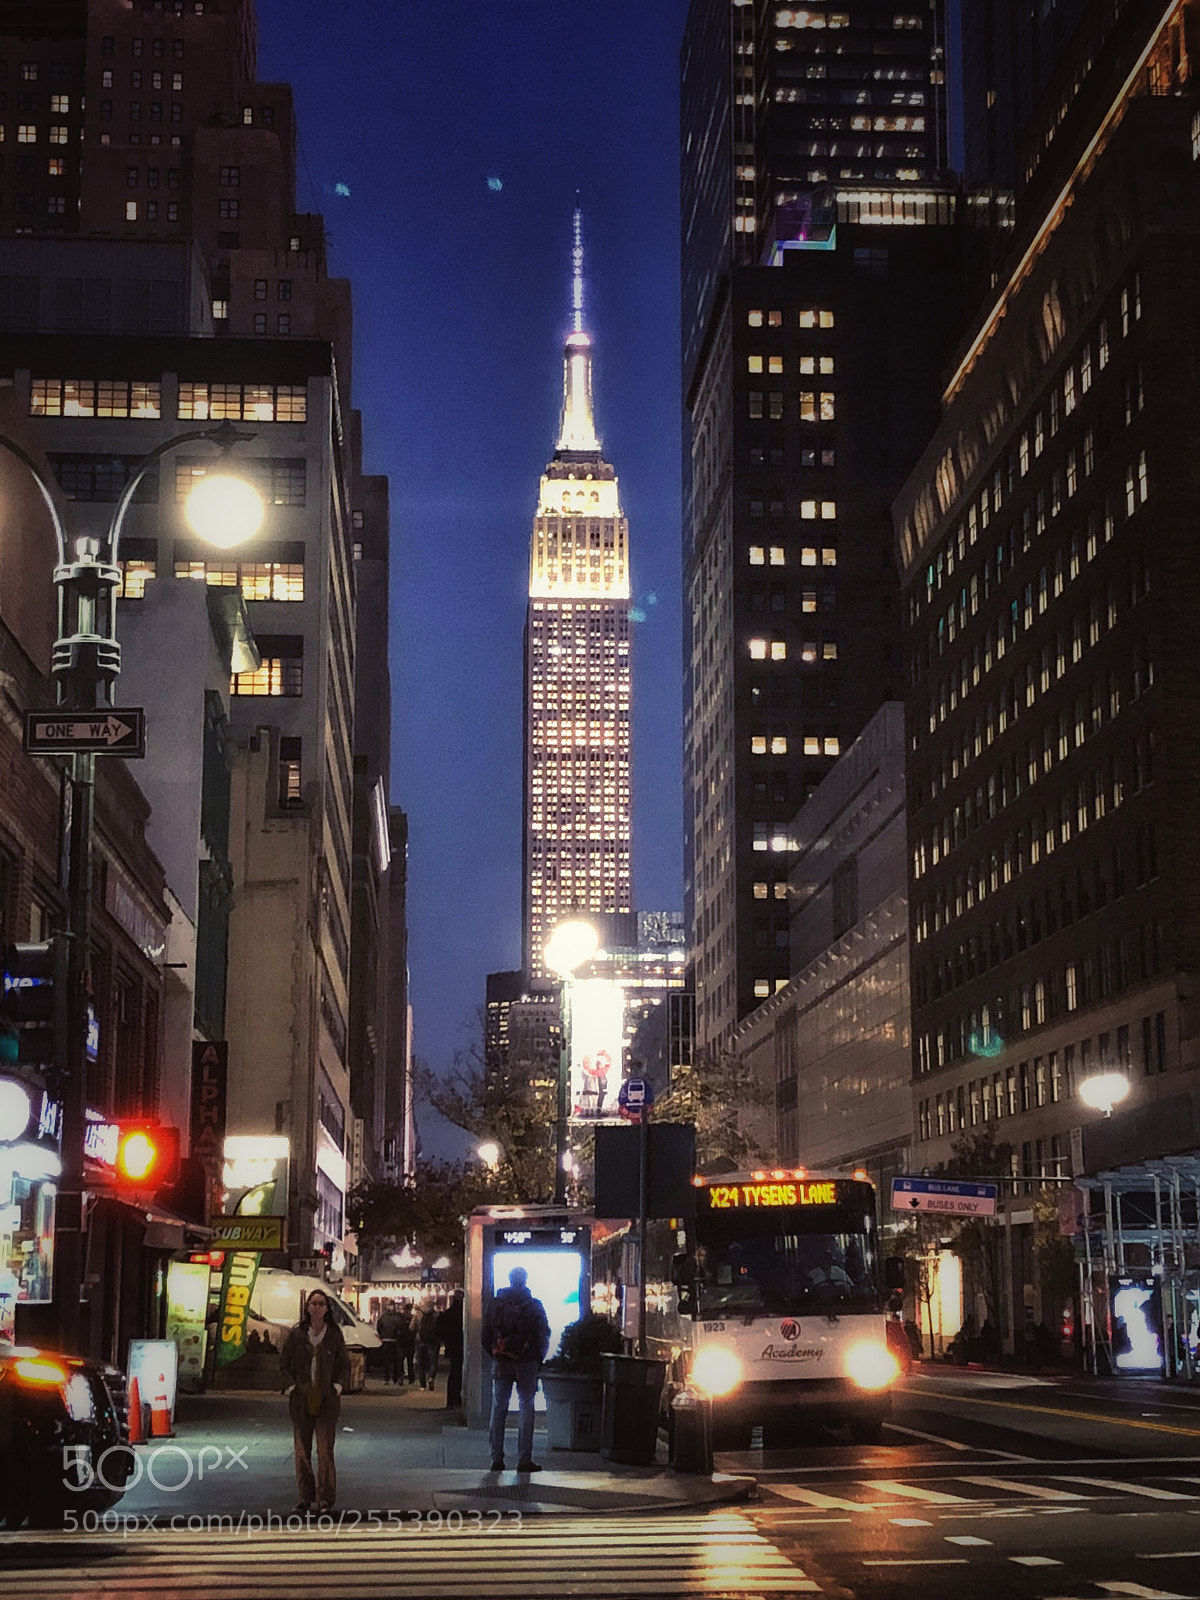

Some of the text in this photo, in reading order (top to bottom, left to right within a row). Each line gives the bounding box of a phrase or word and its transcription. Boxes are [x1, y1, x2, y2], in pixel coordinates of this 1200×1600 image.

[45, 723, 121, 737] ONE WAY
[709, 1183, 836, 1208] X24 TYSENS LANE
[927, 1200, 979, 1211] BUSES ONLY
[212, 1226, 276, 1240] SUBWAY
[221, 1252, 257, 1347] SUBW
[703, 1322, 725, 1333] 1923
[761, 1343, 826, 1361] Academy
